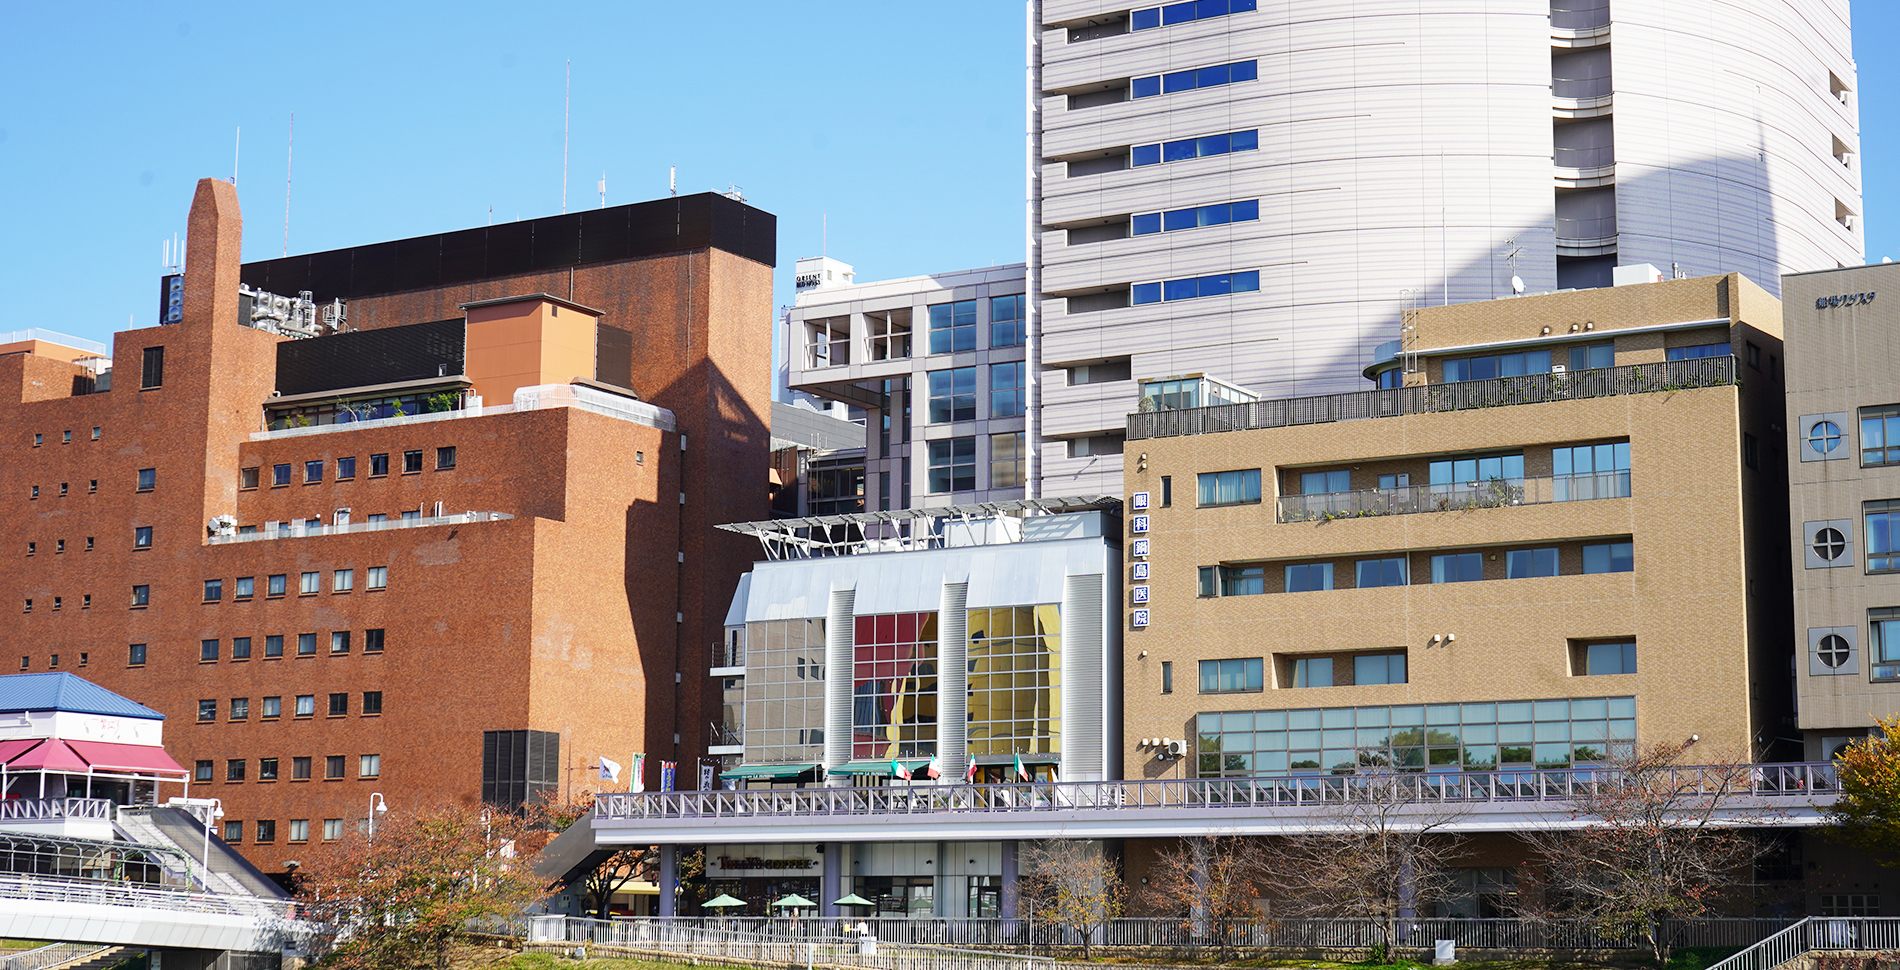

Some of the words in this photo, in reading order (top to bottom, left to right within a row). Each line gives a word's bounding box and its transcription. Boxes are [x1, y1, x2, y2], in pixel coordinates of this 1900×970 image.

[1134, 492, 1149, 627] 眼科鍋島医院
[764, 859, 813, 870] COFFEE
